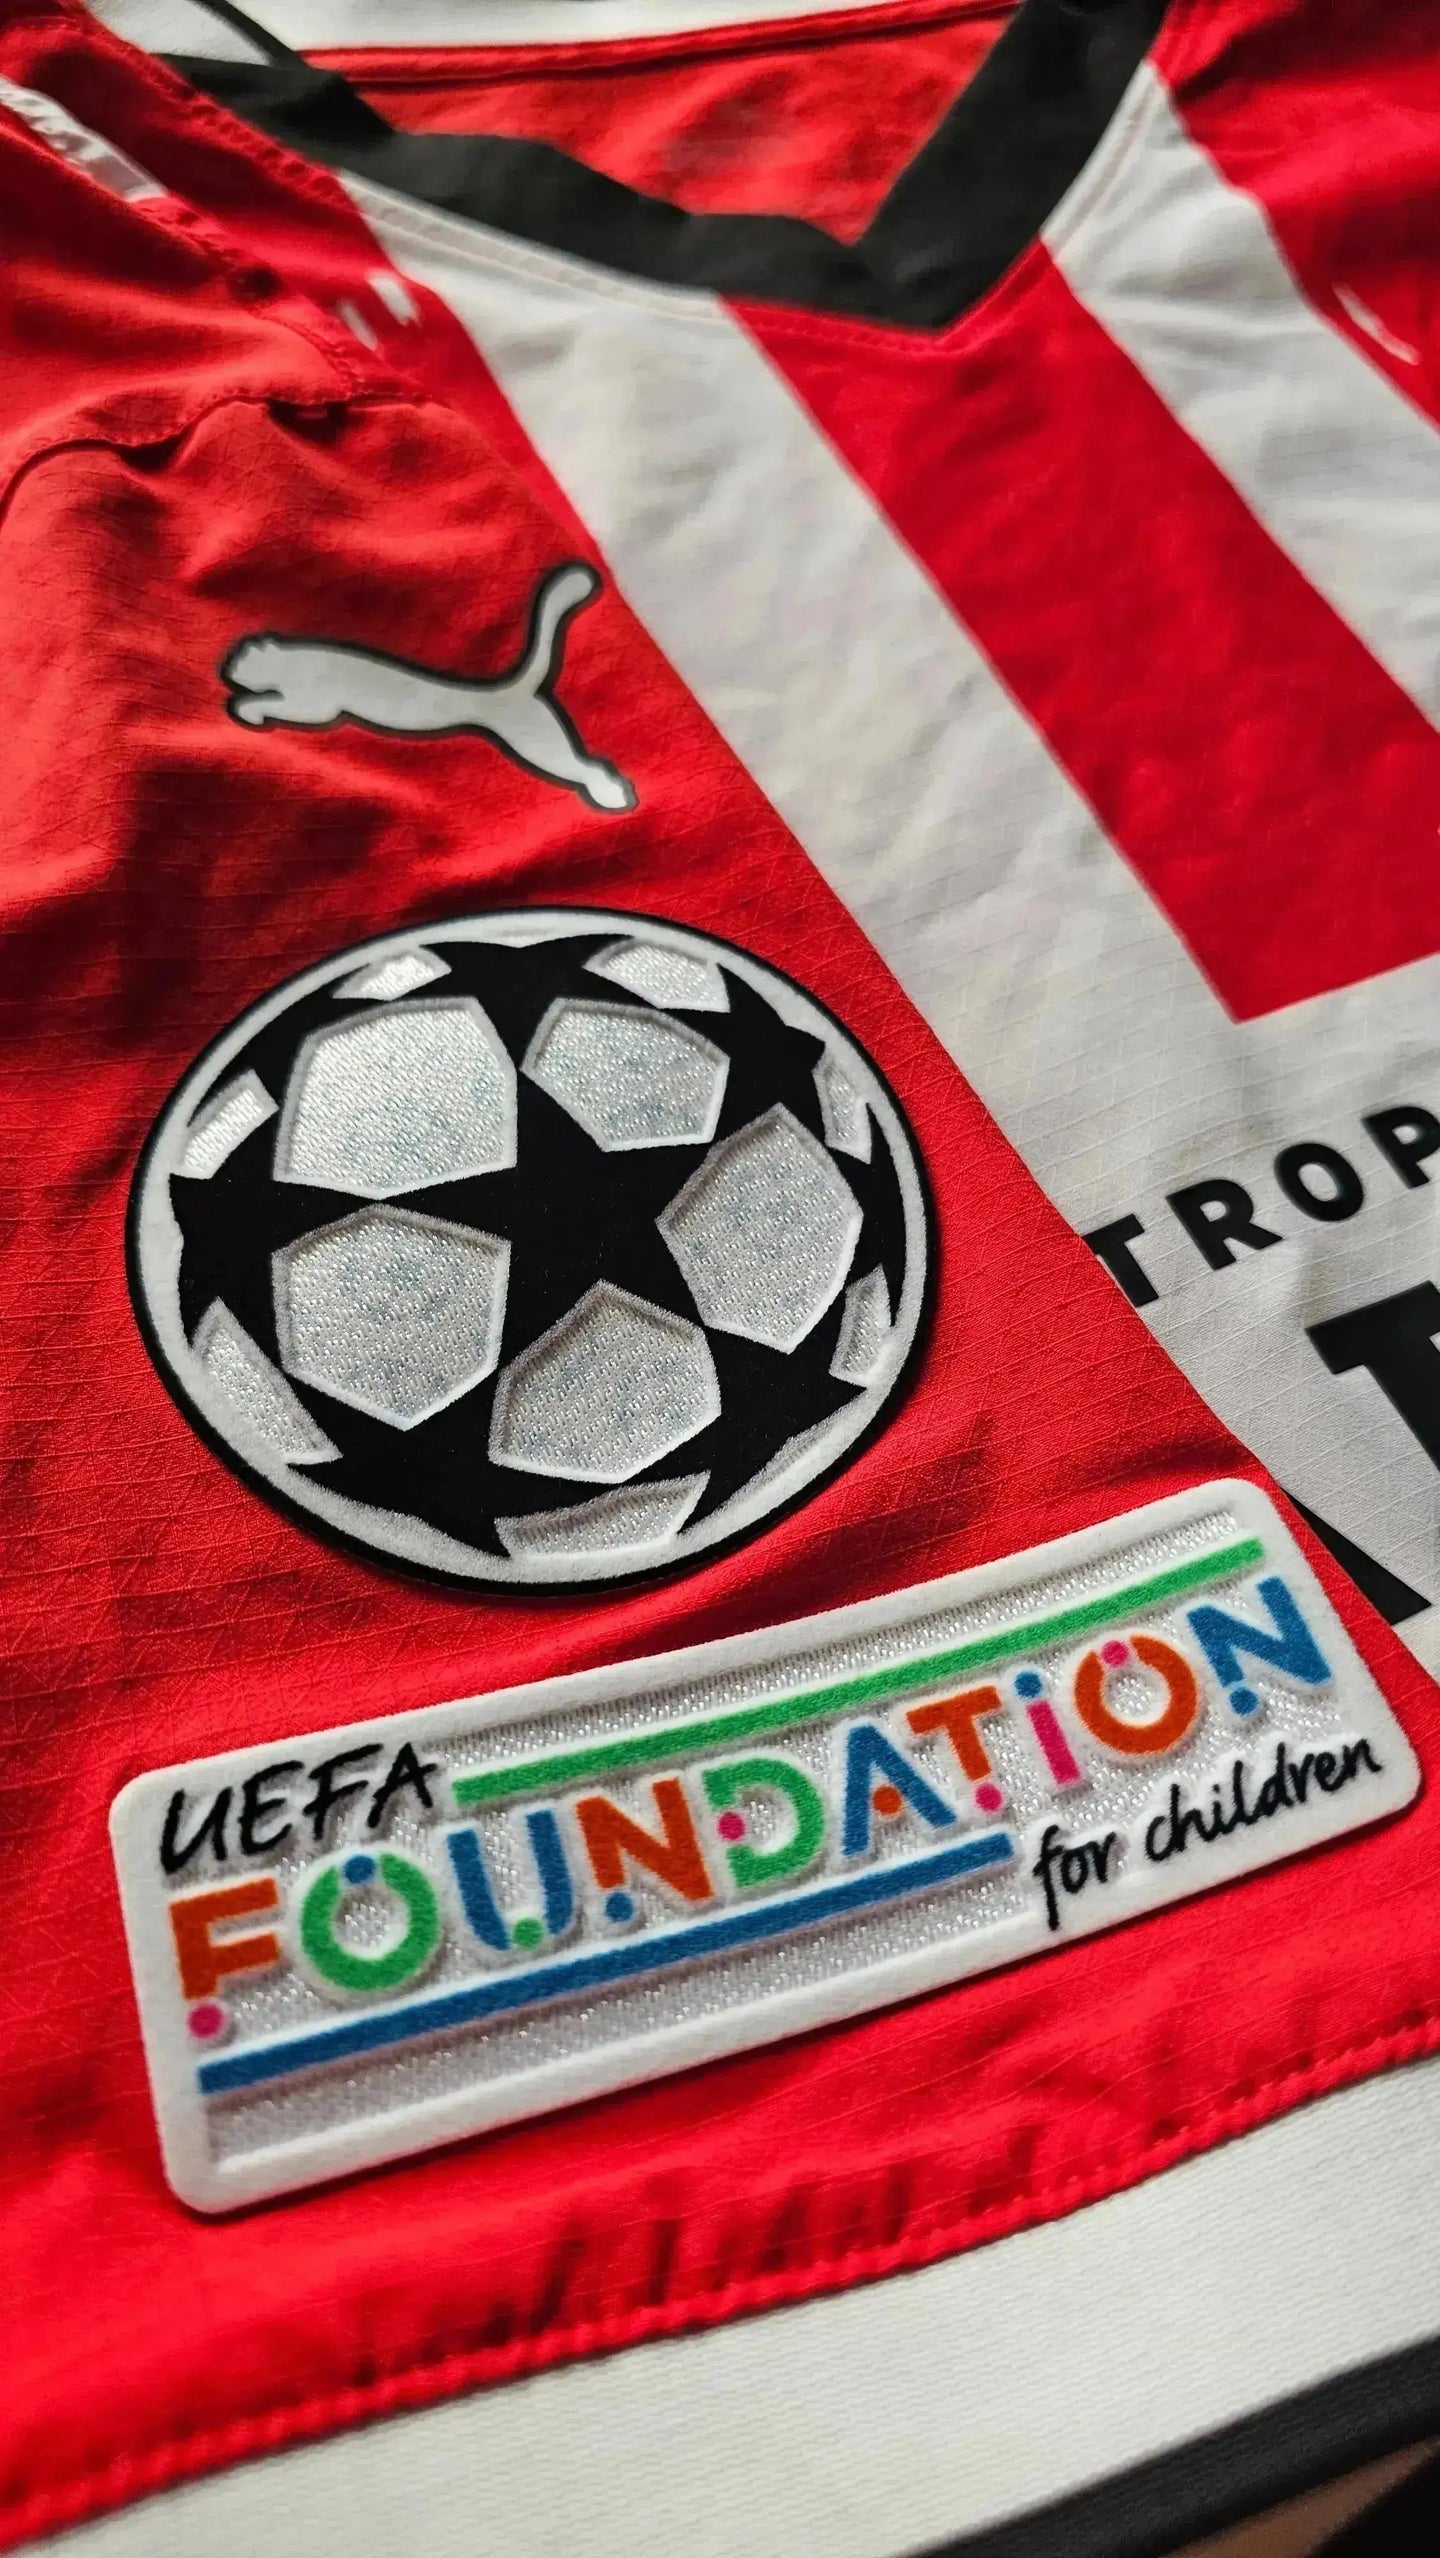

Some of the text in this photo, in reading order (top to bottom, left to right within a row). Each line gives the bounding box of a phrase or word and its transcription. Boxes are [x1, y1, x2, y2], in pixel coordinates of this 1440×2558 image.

[160, 1742, 438, 1874] UEFA
[1032, 1737, 1384, 1931] for children
